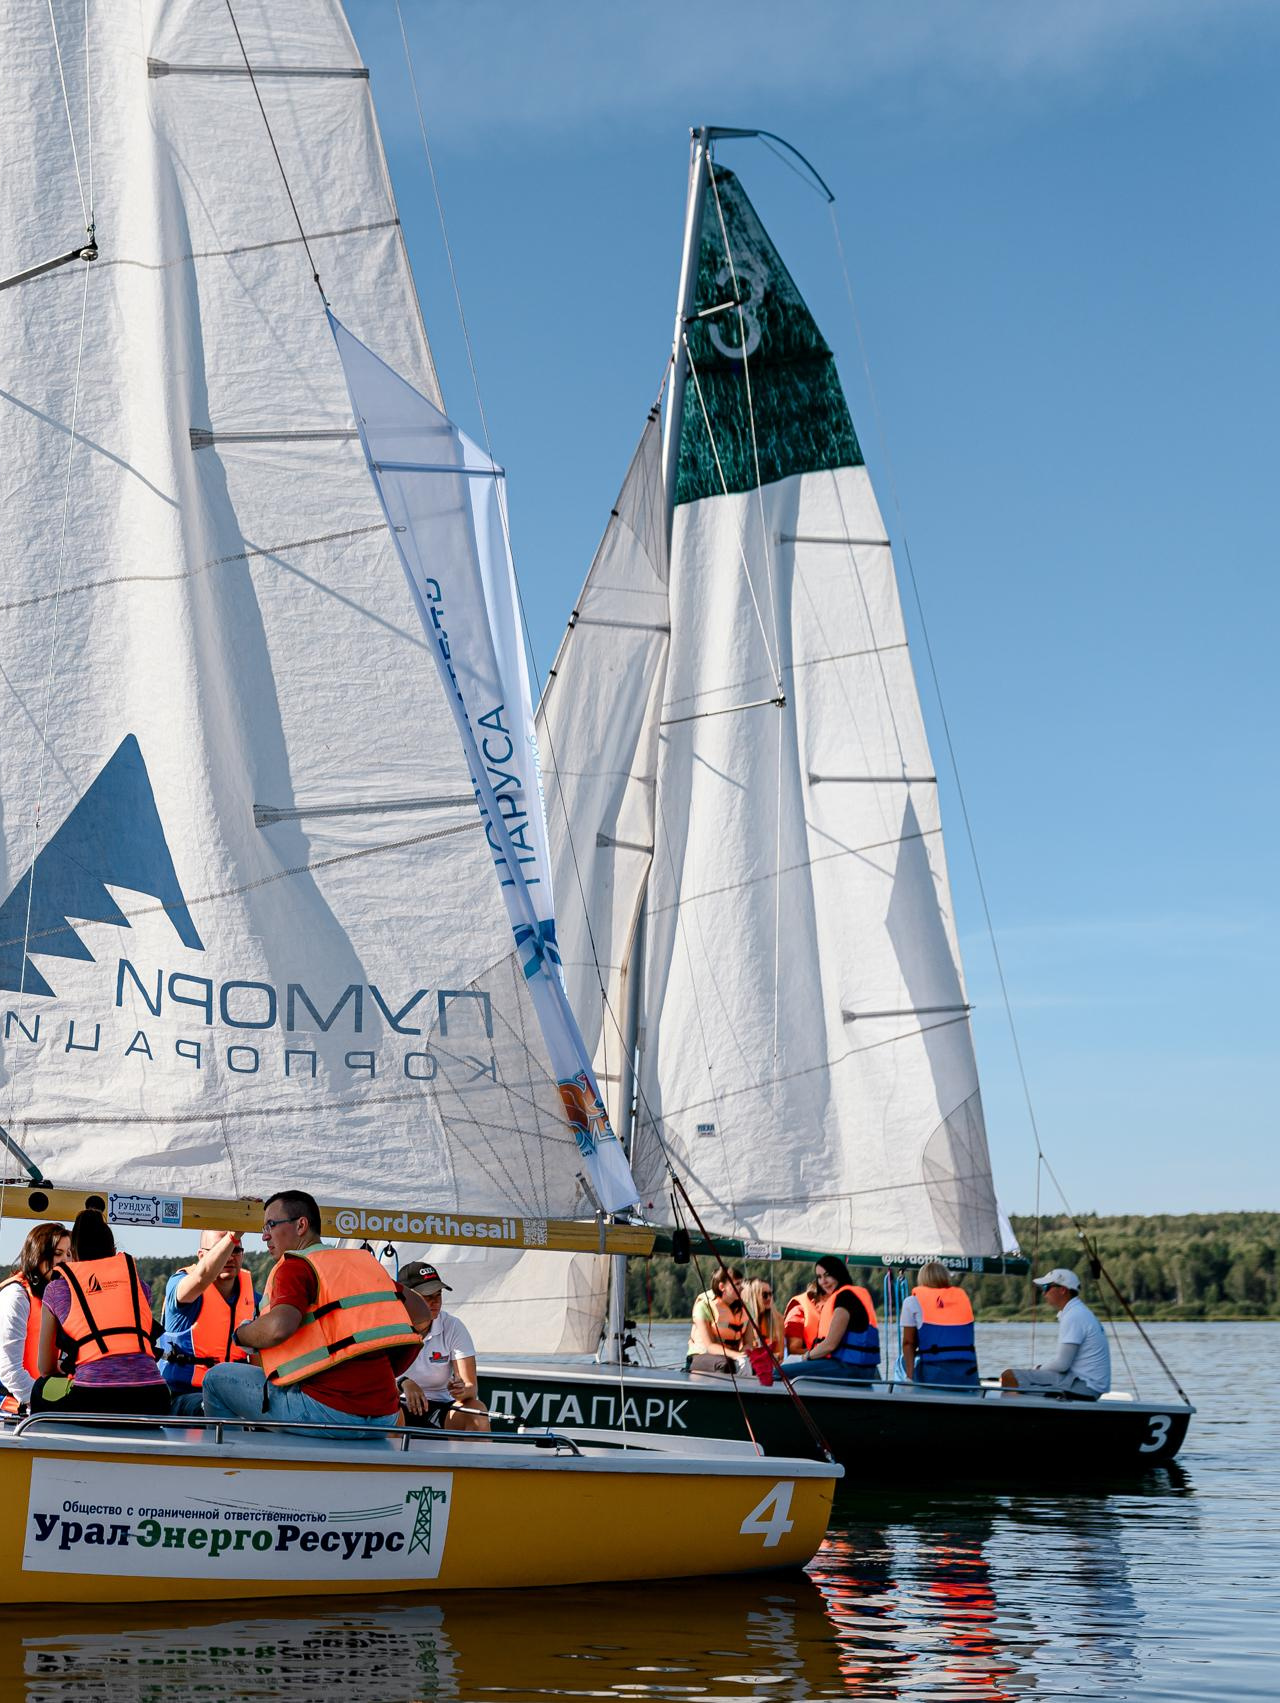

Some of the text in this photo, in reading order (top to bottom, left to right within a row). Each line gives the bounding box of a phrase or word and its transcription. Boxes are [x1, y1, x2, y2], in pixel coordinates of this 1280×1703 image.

[709, 265, 768, 359] 3
[118, 1202, 152, 1212] РУНДУК
[335, 1210, 516, 1239] @lordofthesail
[488, 1390, 689, 1429] ДУГАПАРК
[1139, 1414, 1172, 1452] 3
[63, 1500, 327, 1523] Общество с ограниченной ответственностью
[739, 1480, 796, 1547] 4
